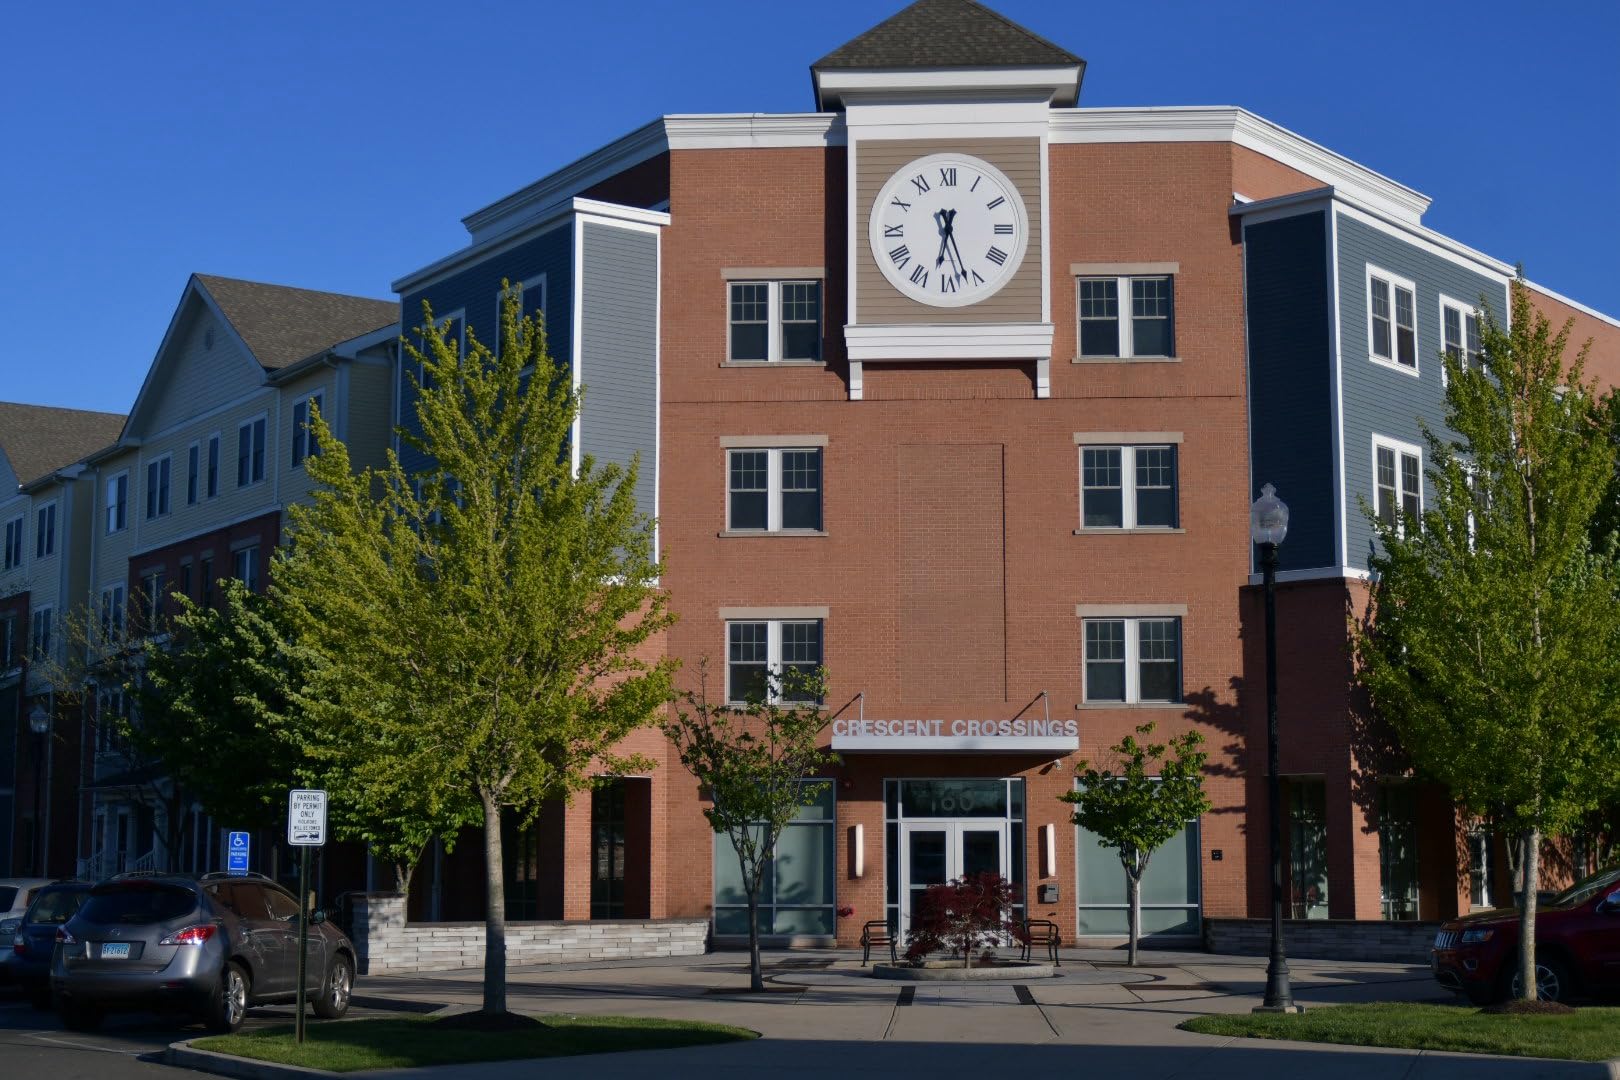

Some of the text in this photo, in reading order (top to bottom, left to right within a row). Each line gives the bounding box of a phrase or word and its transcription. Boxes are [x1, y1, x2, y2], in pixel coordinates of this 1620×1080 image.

[910, 174, 931, 195] XI
[940, 168, 957, 186] XII
[970, 175, 981, 192] I
[891, 196, 911, 212] X
[986, 196, 1005, 210] II
[884, 224, 904, 237] IX
[994, 224, 1013, 234] III
[889, 244, 912, 270] VIII
[909, 264, 929, 288] VII
[941, 274, 956, 293] VI
[971, 268, 985, 287] V
[832, 719, 1079, 736] CRESCENT CROSSINGS
